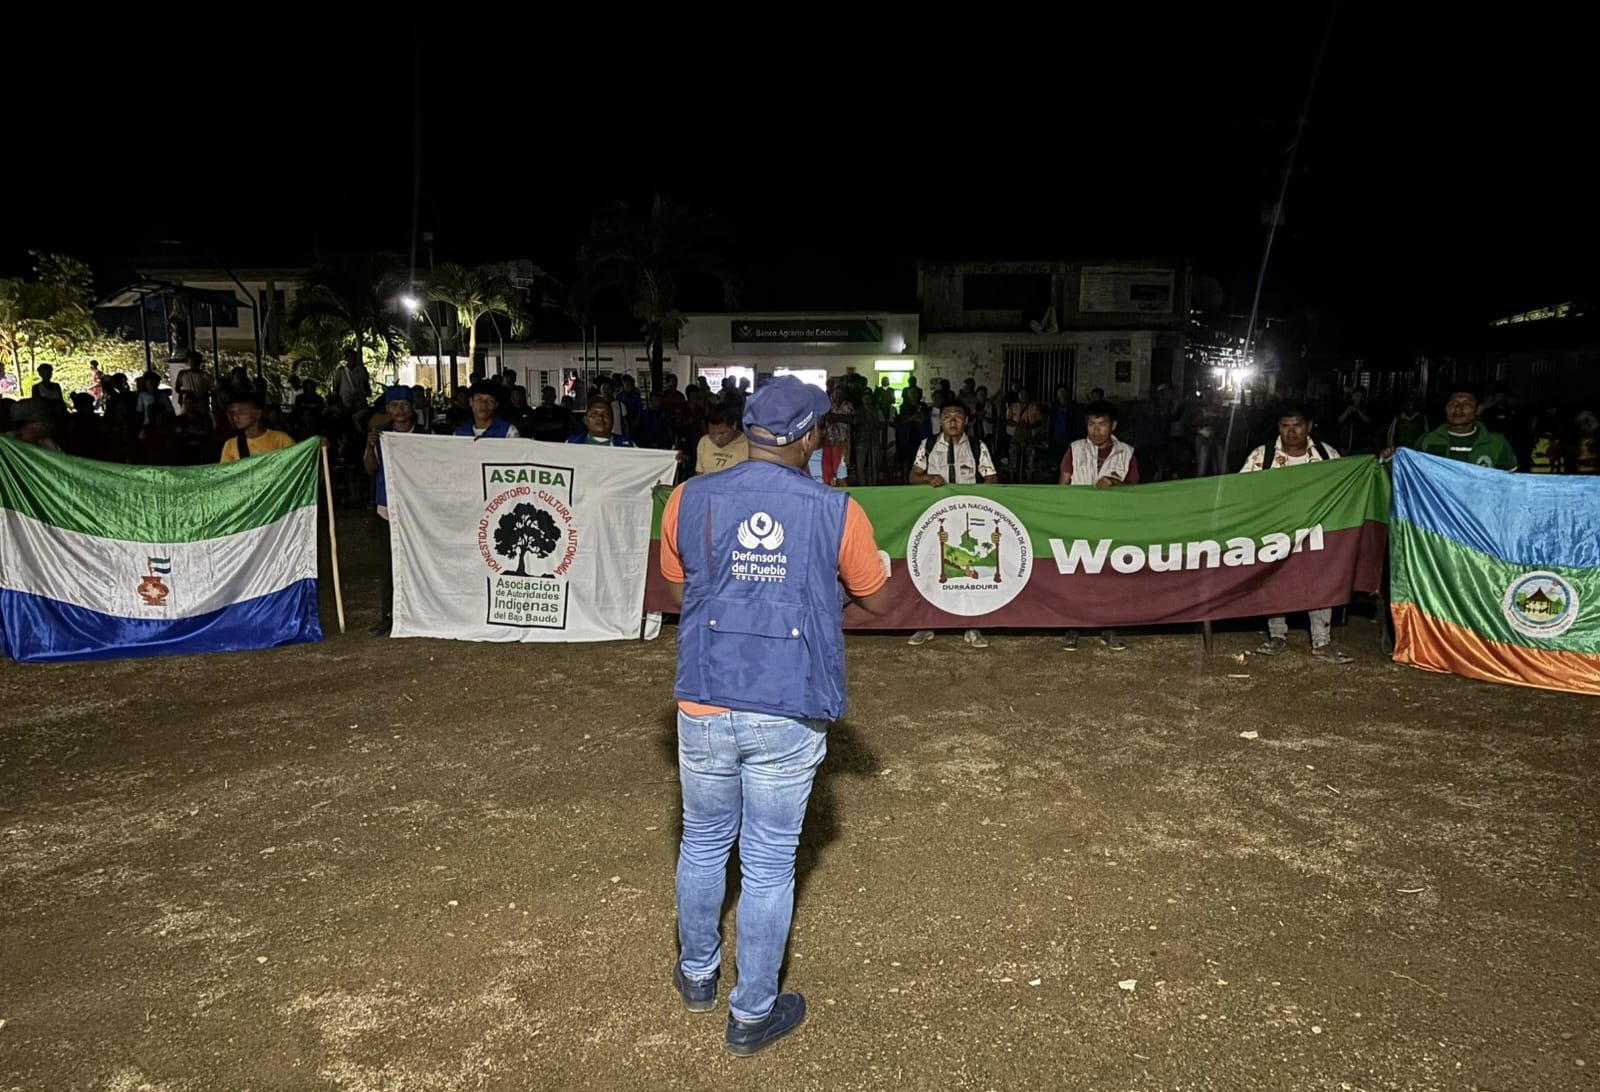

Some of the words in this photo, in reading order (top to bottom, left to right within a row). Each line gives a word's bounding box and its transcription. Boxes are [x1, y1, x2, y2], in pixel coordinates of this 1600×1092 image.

[756, 328, 777, 337] Banco
[779, 328, 805, 339] Agrario
[805, 329, 815, 337] de
[815, 328, 849, 337] Colombia
[714, 457, 727, 467] 77
[490, 469, 566, 487] ASAIBA
[485, 486, 531, 514] TERRITORIO
[538, 490, 573, 524] CULTURA
[921, 507, 949, 531] NACIONAL
[1017, 536, 1025, 545] DE
[478, 519, 502, 573] HONESTIDAD
[1048, 523, 1325, 575] Wounaan
[732, 562, 748, 574] del
[750, 563, 787, 575] Pueblo
[496, 578, 560, 592] Asociación
[496, 589, 505, 597] de
[506, 589, 560, 601] Autoridades
[494, 611, 506, 620] del
[508, 612, 523, 622] Bajo
[525, 613, 558, 623] Baudó
